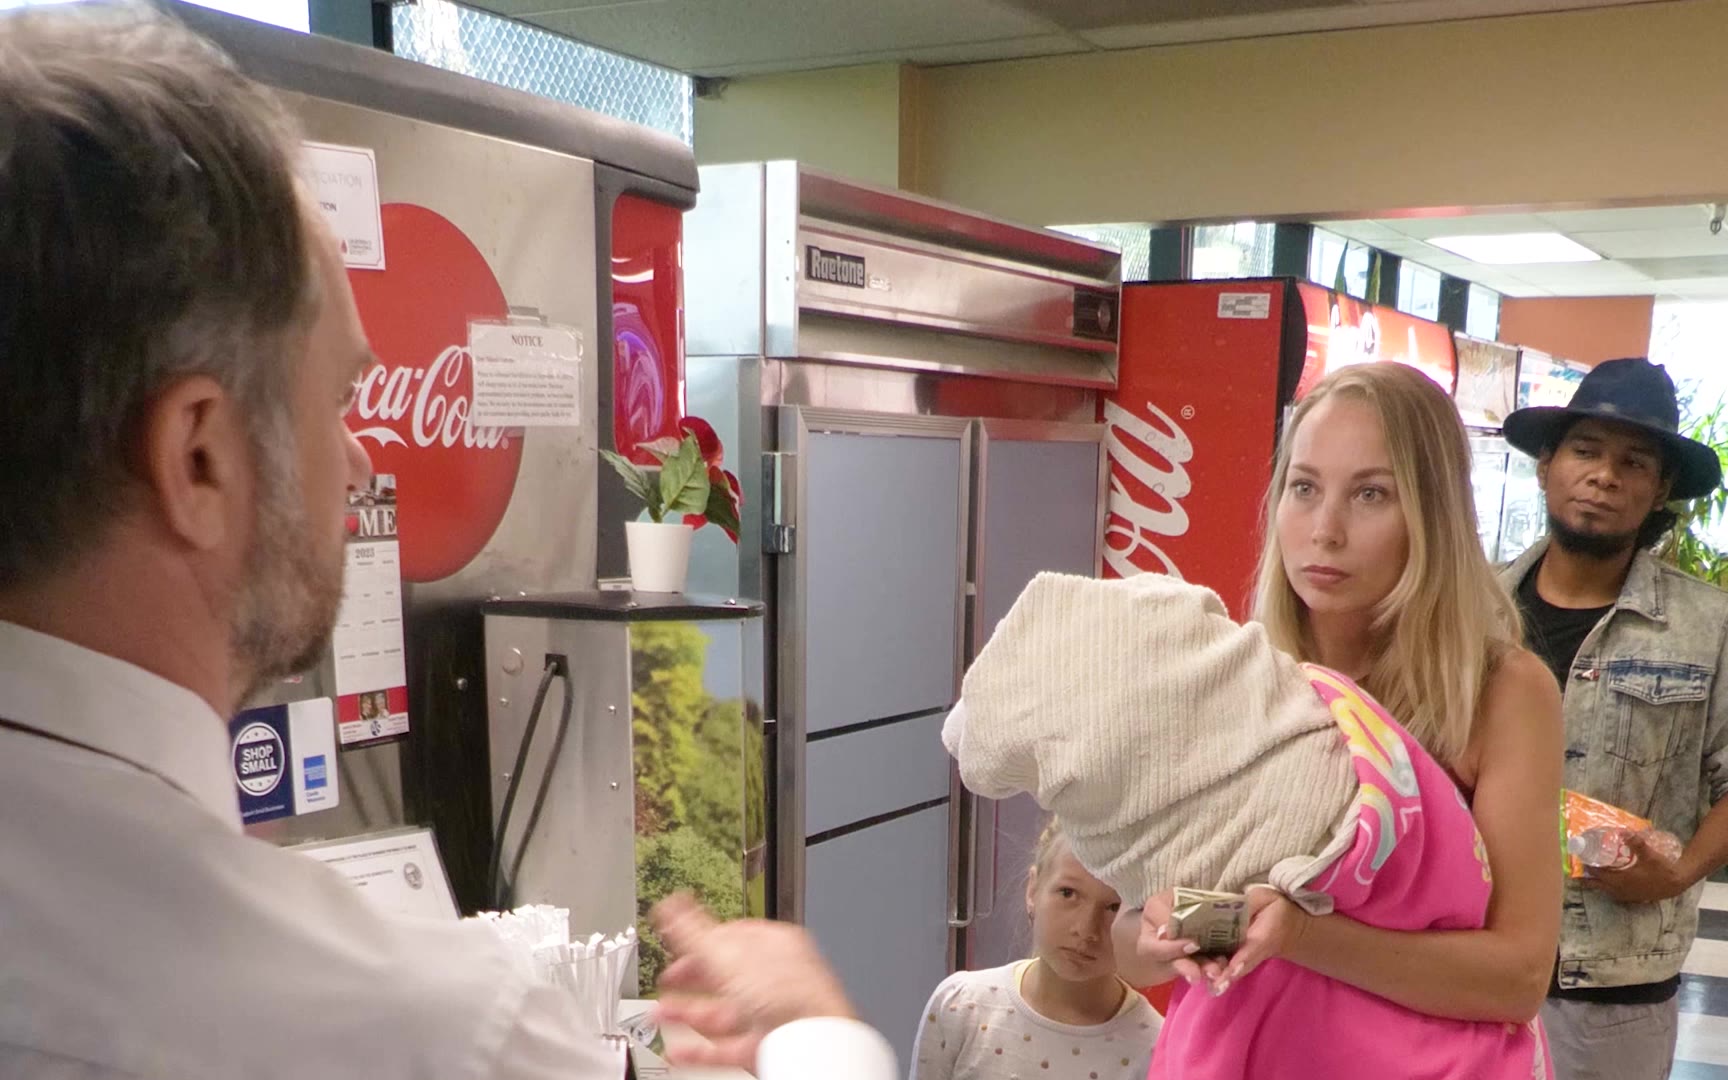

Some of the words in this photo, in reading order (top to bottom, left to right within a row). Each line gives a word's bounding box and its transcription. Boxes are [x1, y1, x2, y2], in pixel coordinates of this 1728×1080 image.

[811, 248, 864, 285] Raetone
[511, 334, 545, 347] NOTICE
[242, 744, 274, 762] SHOP
[241, 757, 278, 775] SMALL
